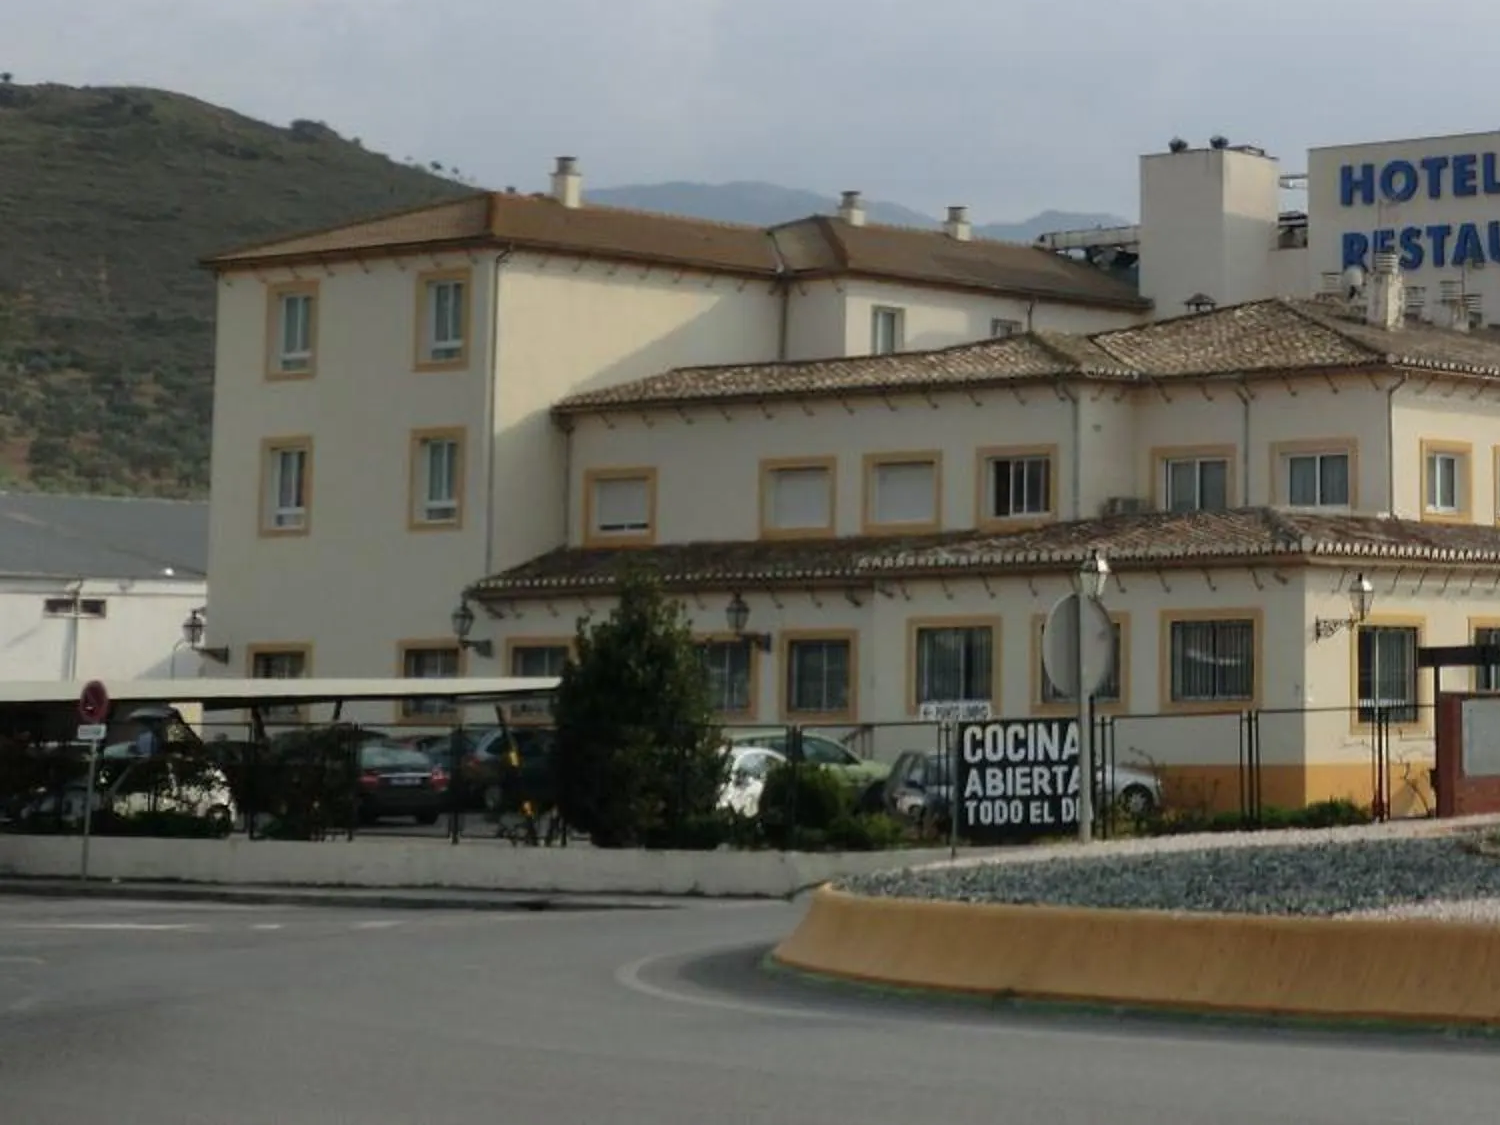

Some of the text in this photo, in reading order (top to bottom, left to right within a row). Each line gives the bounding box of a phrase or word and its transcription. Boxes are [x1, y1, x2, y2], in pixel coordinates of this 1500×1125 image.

[963, 721, 1081, 763] COCINA
[963, 765, 1081, 798] ABIERTA
[964, 798, 1023, 826] TODO
[1029, 800, 1055, 824] EL
